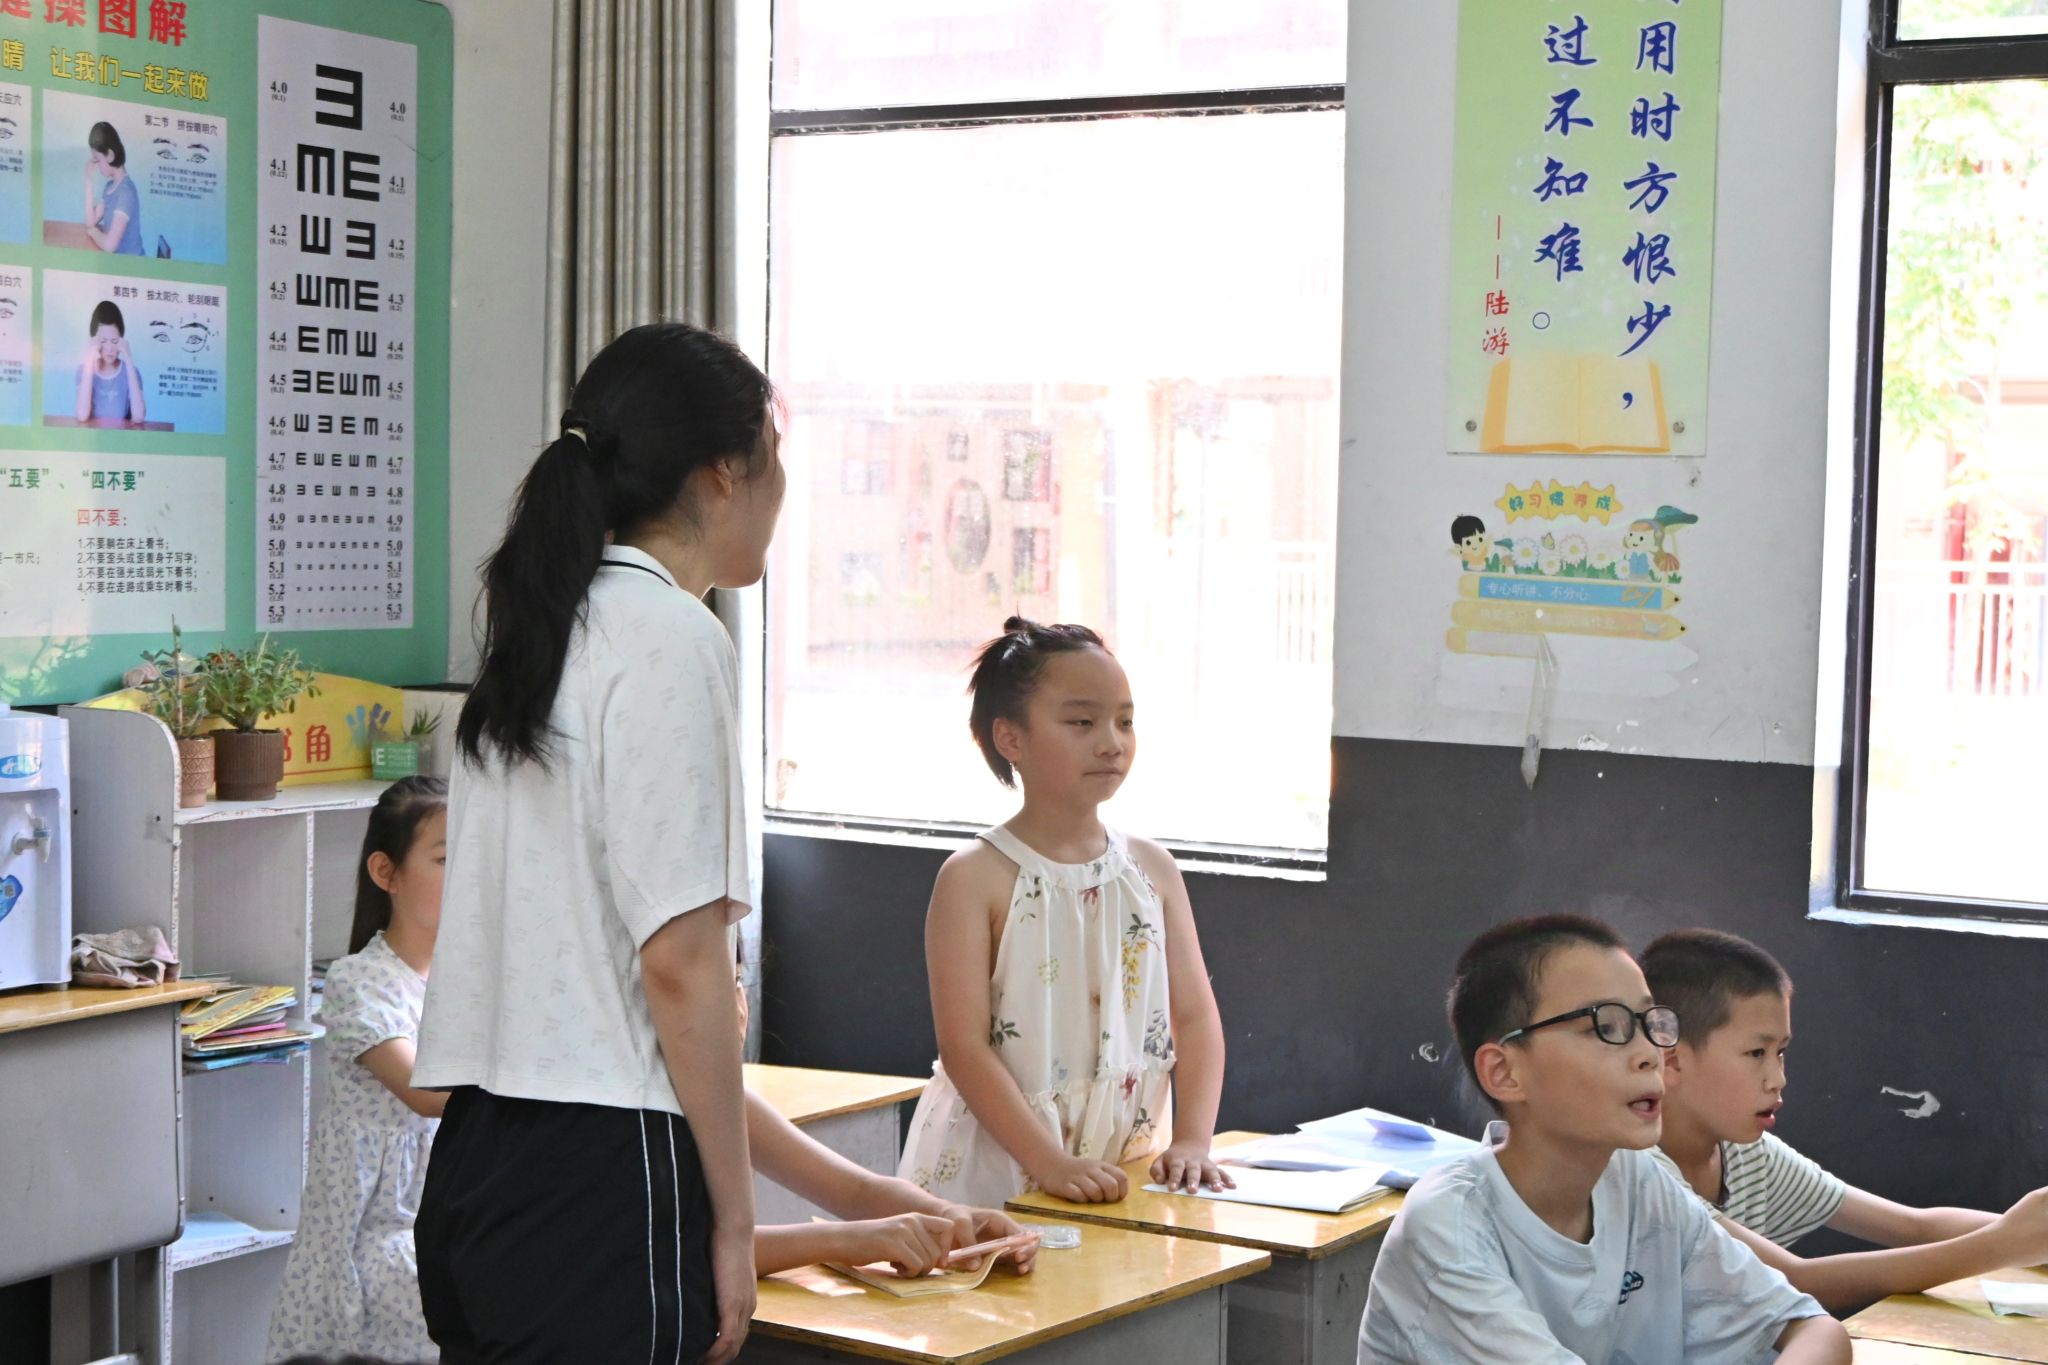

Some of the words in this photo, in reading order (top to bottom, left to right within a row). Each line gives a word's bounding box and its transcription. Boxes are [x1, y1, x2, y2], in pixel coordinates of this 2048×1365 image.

[0, 0, 188, 47] 操图解
[50, 46, 209, 101] 让我们一起来做
[270, 80, 288, 94] 4.0
[390, 102, 406, 114] 4.0
[144, 114, 169, 128] 第二节
[270, 159, 287, 172] 4.1
[389, 176, 406, 188] 4.1
[270, 224, 287, 237] 4.2
[388, 239, 404, 250] 4.2
[113, 285, 139, 299] 第四节
[270, 282, 287, 294] 4.3
[388, 293, 404, 304] 4.3
[269, 331, 287, 342] 4.4
[387, 341, 404, 352] 4.4
[269, 374, 286, 386] 4.5
[387, 382, 404, 393] 4.5
[269, 417, 286, 428] 4.6
[387, 422, 404, 434] 4.6
[268, 452, 286, 464] 4.7
[386, 457, 404, 468] 4.7
[268, 484, 286, 495] 4.8
[386, 487, 403, 498] 4.8
[268, 513, 286, 524] 4.9
[386, 515, 403, 525] 4.9
[268, 540, 286, 550] 5.0
[386, 540, 403, 551] 5.0
[268, 562, 285, 573] 5.1
[387, 561, 402, 572] 5.1
[268, 584, 285, 595] 5.2
[387, 583, 402, 594] 5.2
[268, 606, 285, 617] 5.3
[386, 604, 402, 614] 5.3
